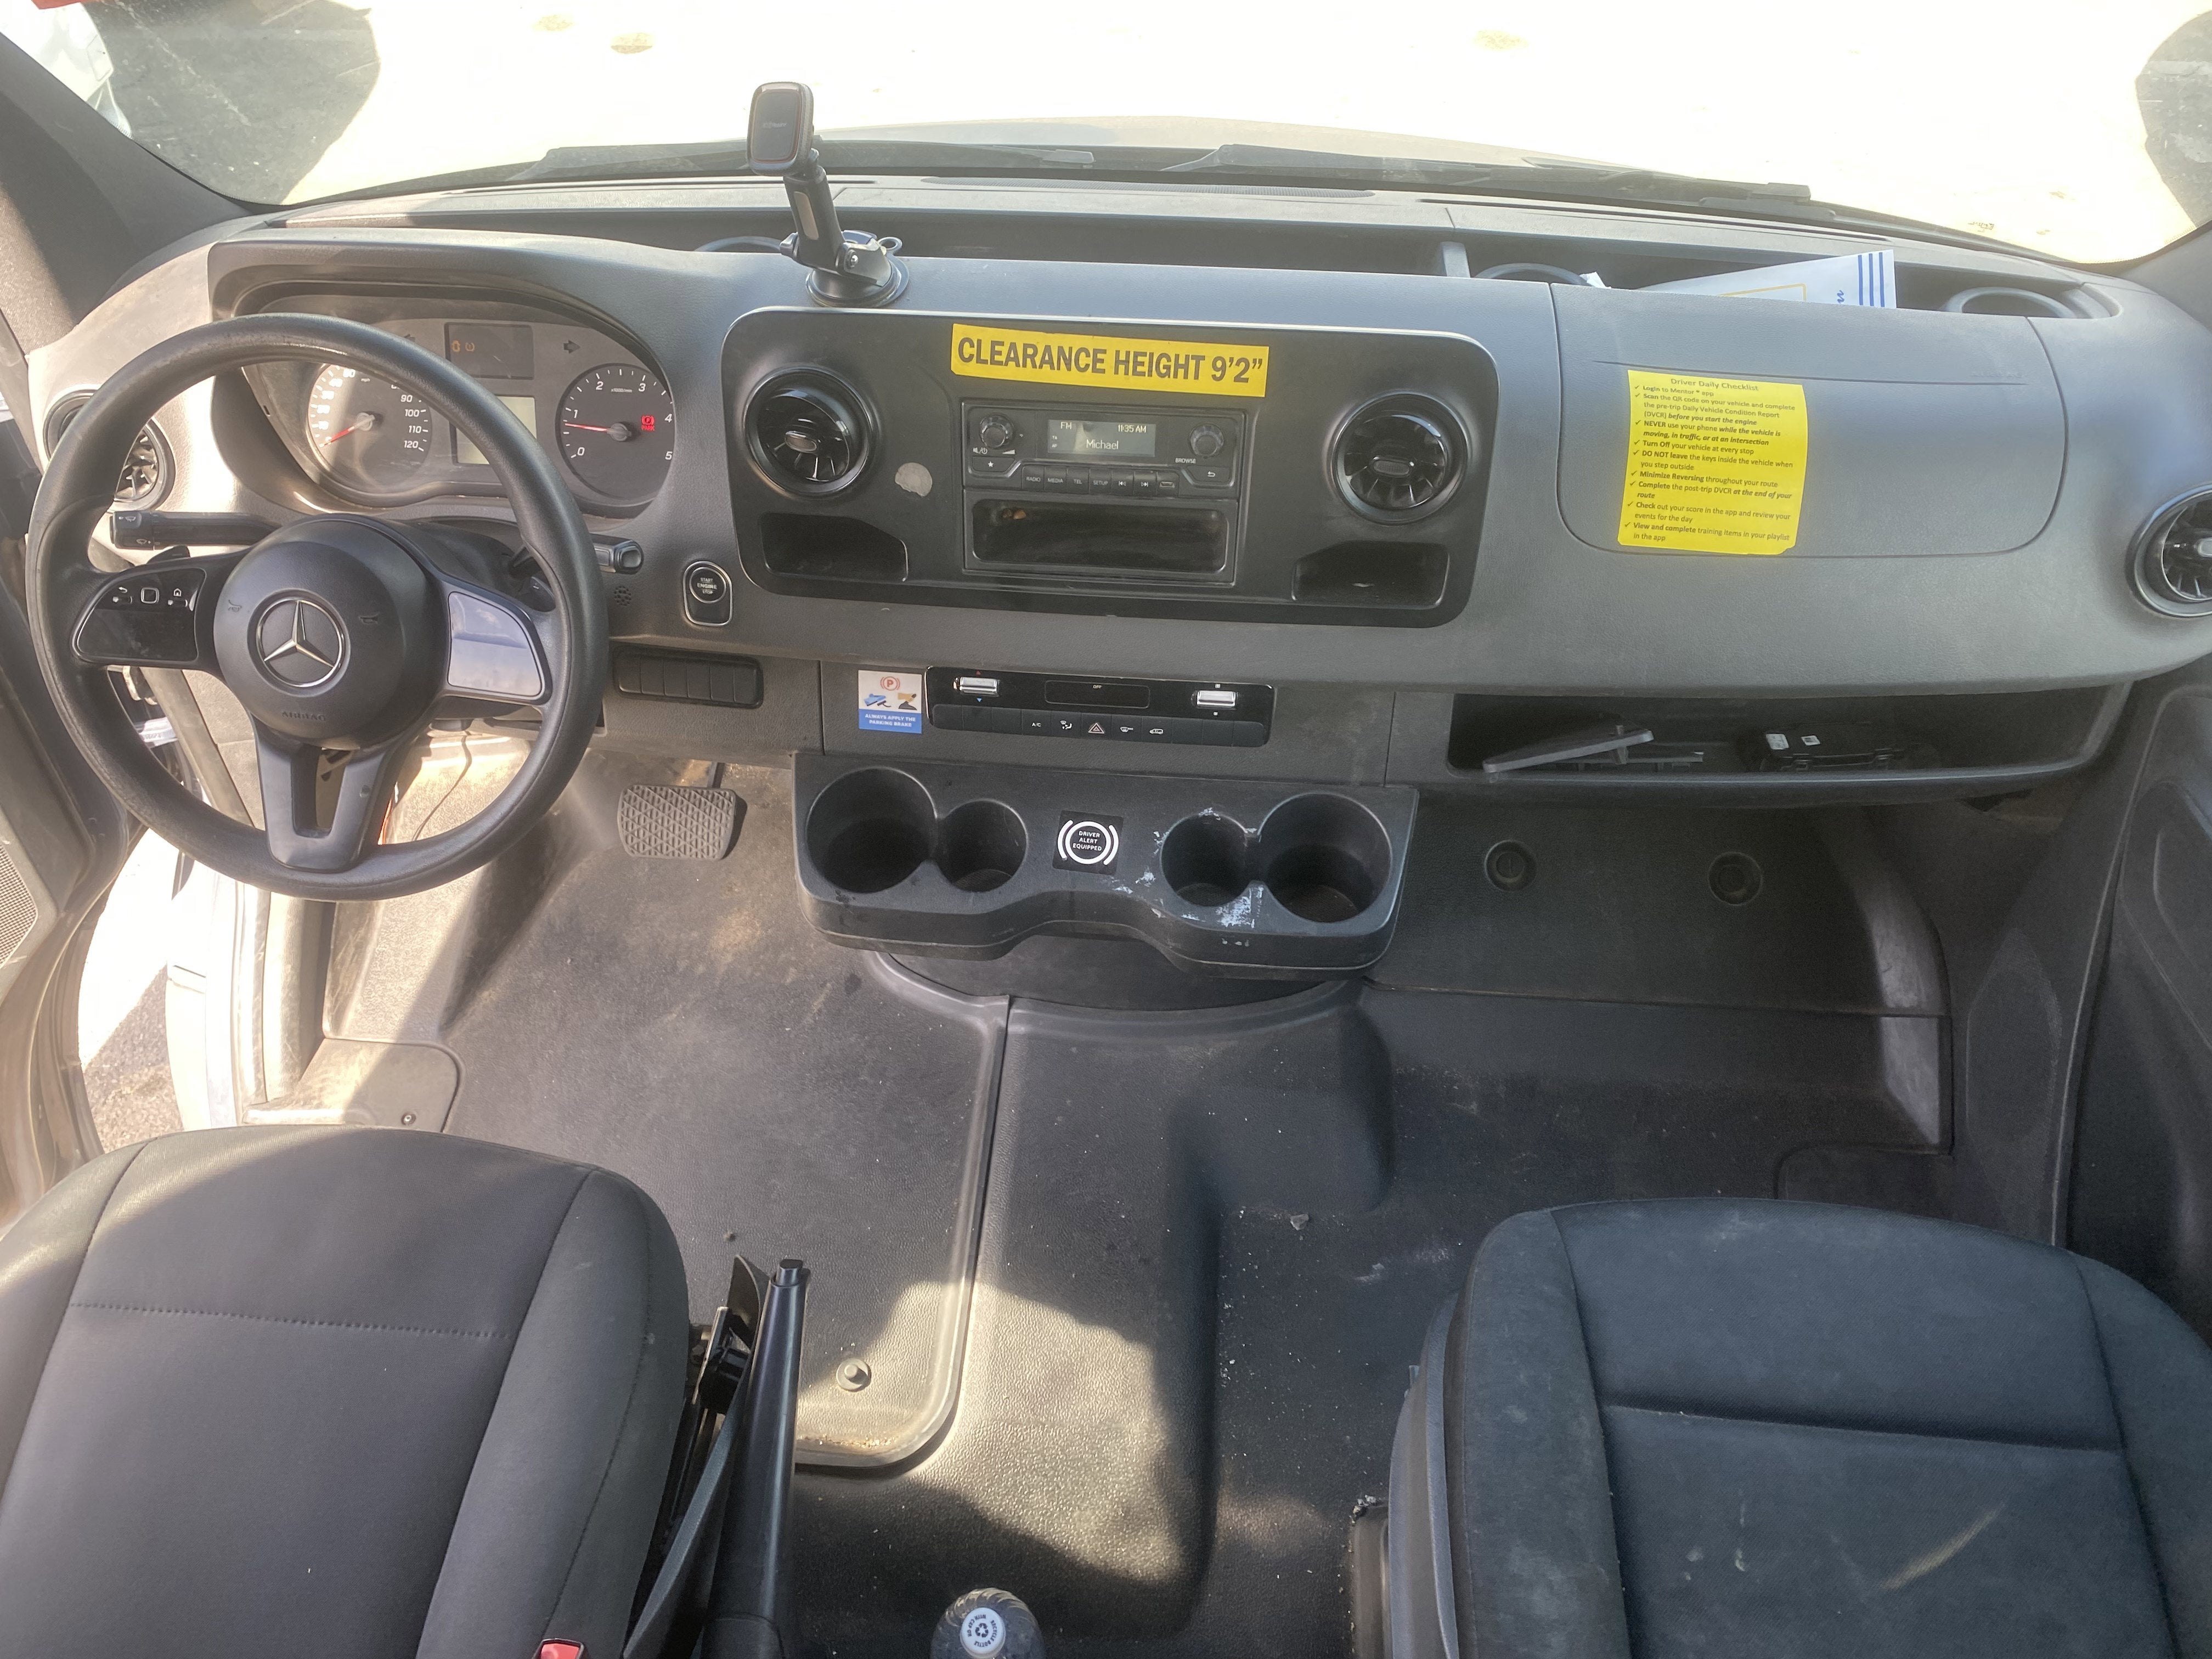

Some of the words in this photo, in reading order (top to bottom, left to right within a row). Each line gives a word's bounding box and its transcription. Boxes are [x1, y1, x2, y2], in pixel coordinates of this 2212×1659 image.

[958, 337, 1107, 374] CLEARANCE
[1114, 349, 1206, 380] HEIGHT
[596, 381, 603, 391] 2
[638, 383, 646, 392] 3
[1722, 382, 1759, 391] Checklist
[400, 394, 413, 403] 90
[405, 409, 420, 417] 100
[574, 409, 578, 419] 1
[664, 414, 672, 422] 4
[1118, 424, 1134, 432] 11:35
[1680, 433, 1701, 441] traffic,
[1730, 437, 1769, 445] intersection
[404, 441, 419, 449] 120
[1086, 439, 1119, 450] Michael
[577, 447, 585, 456] 0
[665, 451, 673, 460] 5
[1640, 471, 1671, 479] Minimize
[1672, 473, 1705, 482] Reversing
[1706, 476, 1742, 484] throughout
[1638, 481, 1671, 489] Complete
[1681, 515, 1693, 523] day
[1697, 527, 1722, 536] training
[1073, 843, 1102, 851] EQUIPPED
